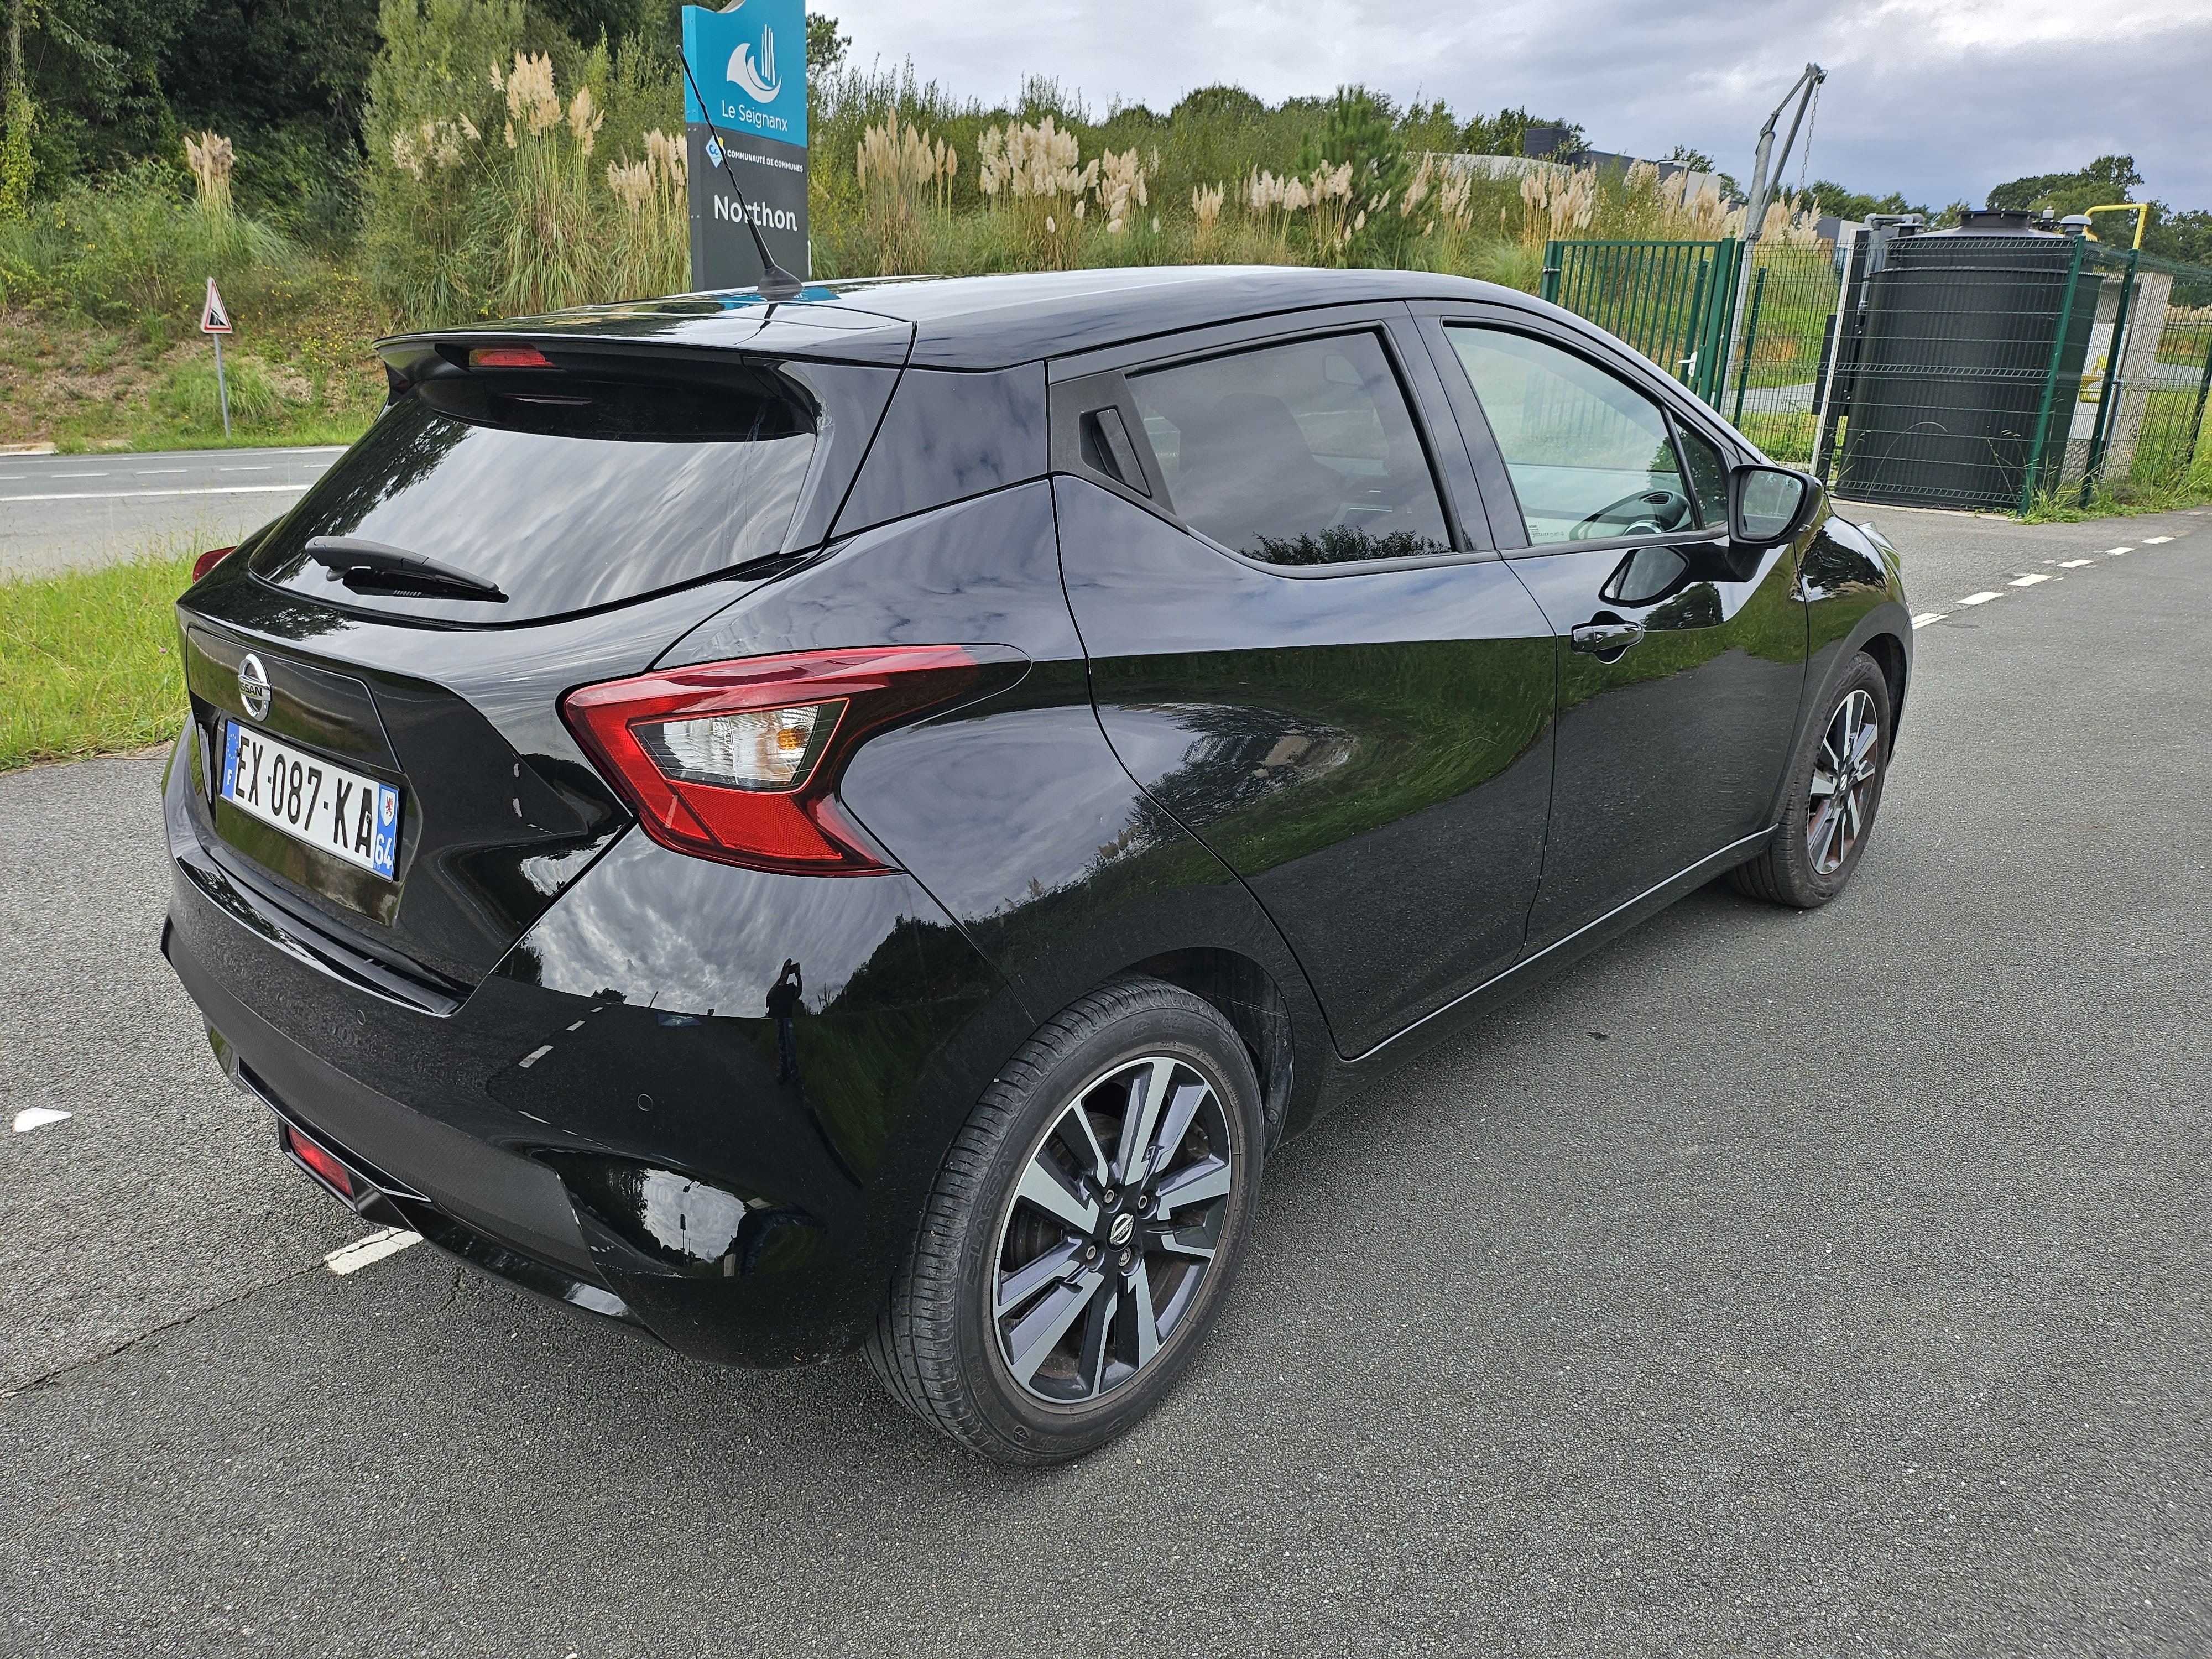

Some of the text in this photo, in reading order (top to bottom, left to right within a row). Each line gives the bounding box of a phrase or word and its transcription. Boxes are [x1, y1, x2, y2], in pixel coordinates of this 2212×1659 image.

[722, 99, 788, 132] Le Seignanx
[727, 149, 804, 173] COMMUNAUTÉ DE COMMUNES
[714, 194, 797, 232] Northon
[239, 681, 263, 697] SSAN
[227, 769, 233, 785] F
[375, 833, 393, 869] 64
